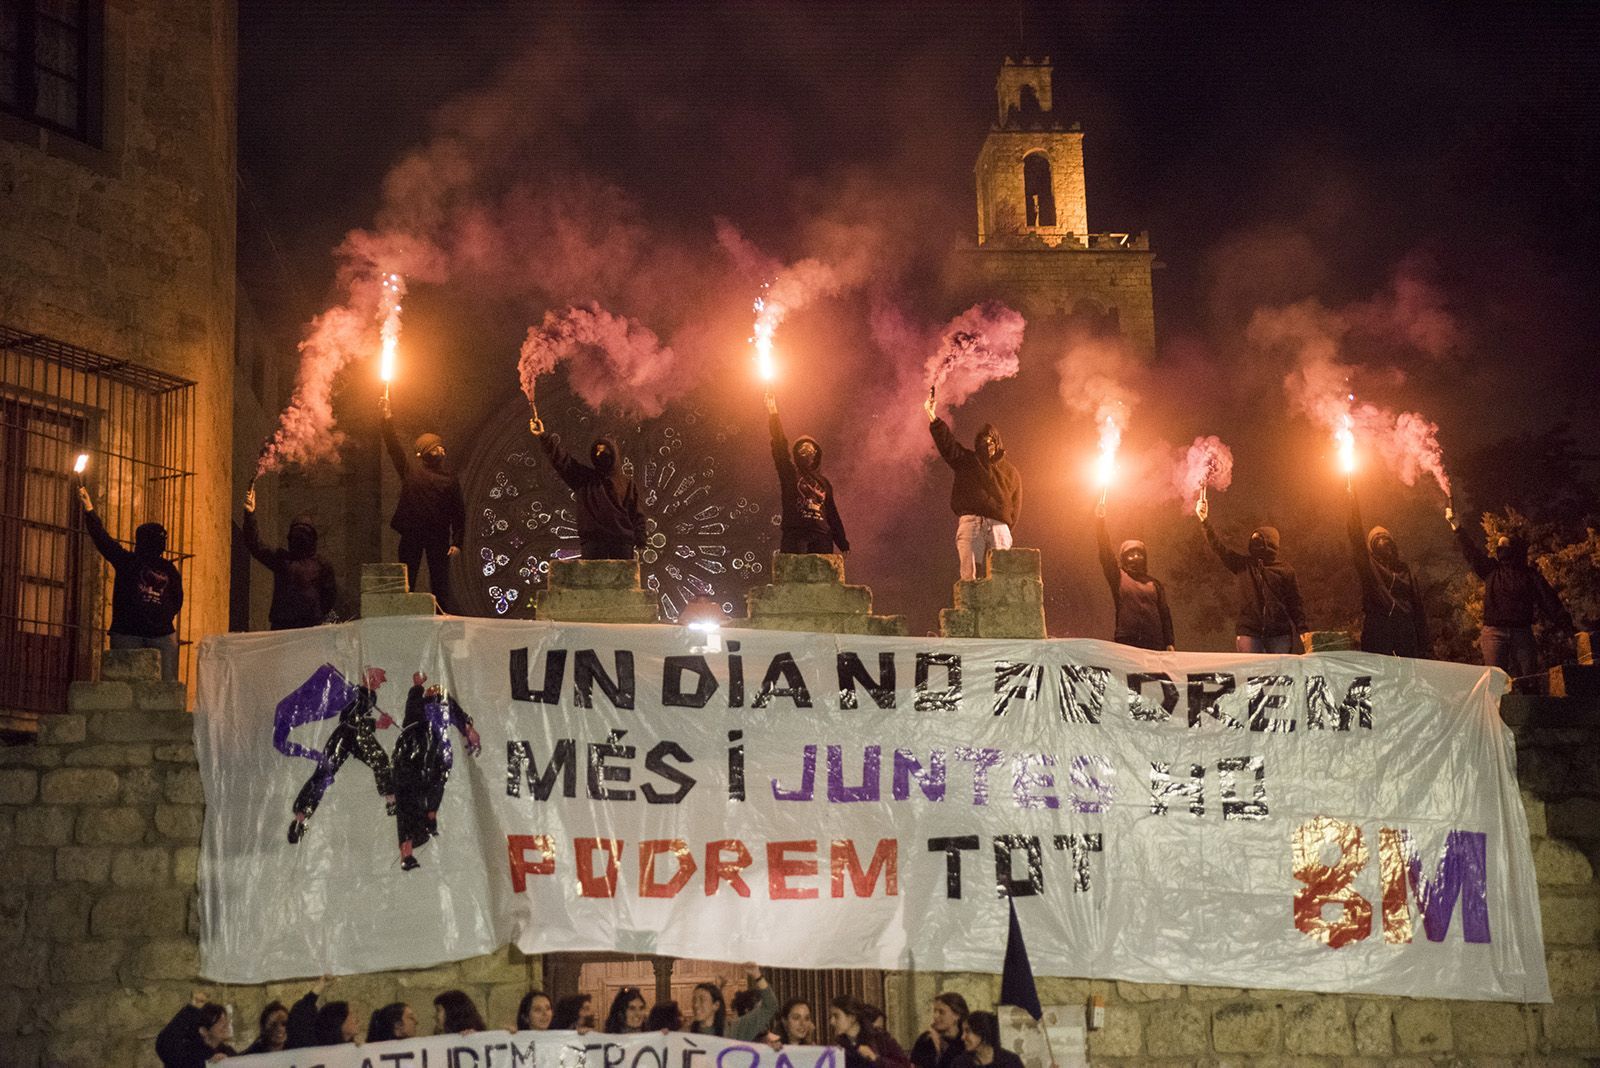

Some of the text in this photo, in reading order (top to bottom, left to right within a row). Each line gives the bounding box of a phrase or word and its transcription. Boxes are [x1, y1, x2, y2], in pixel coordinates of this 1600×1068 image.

[509, 647, 635, 710] UN
[837, 652, 963, 712] NO
[506, 728, 698, 804] MÉS
[770, 744, 1116, 814] JUNTES
[1148, 755, 1270, 821] HO
[506, 832, 1103, 900] PODREM TOT
[1291, 814, 1491, 950] 8M
